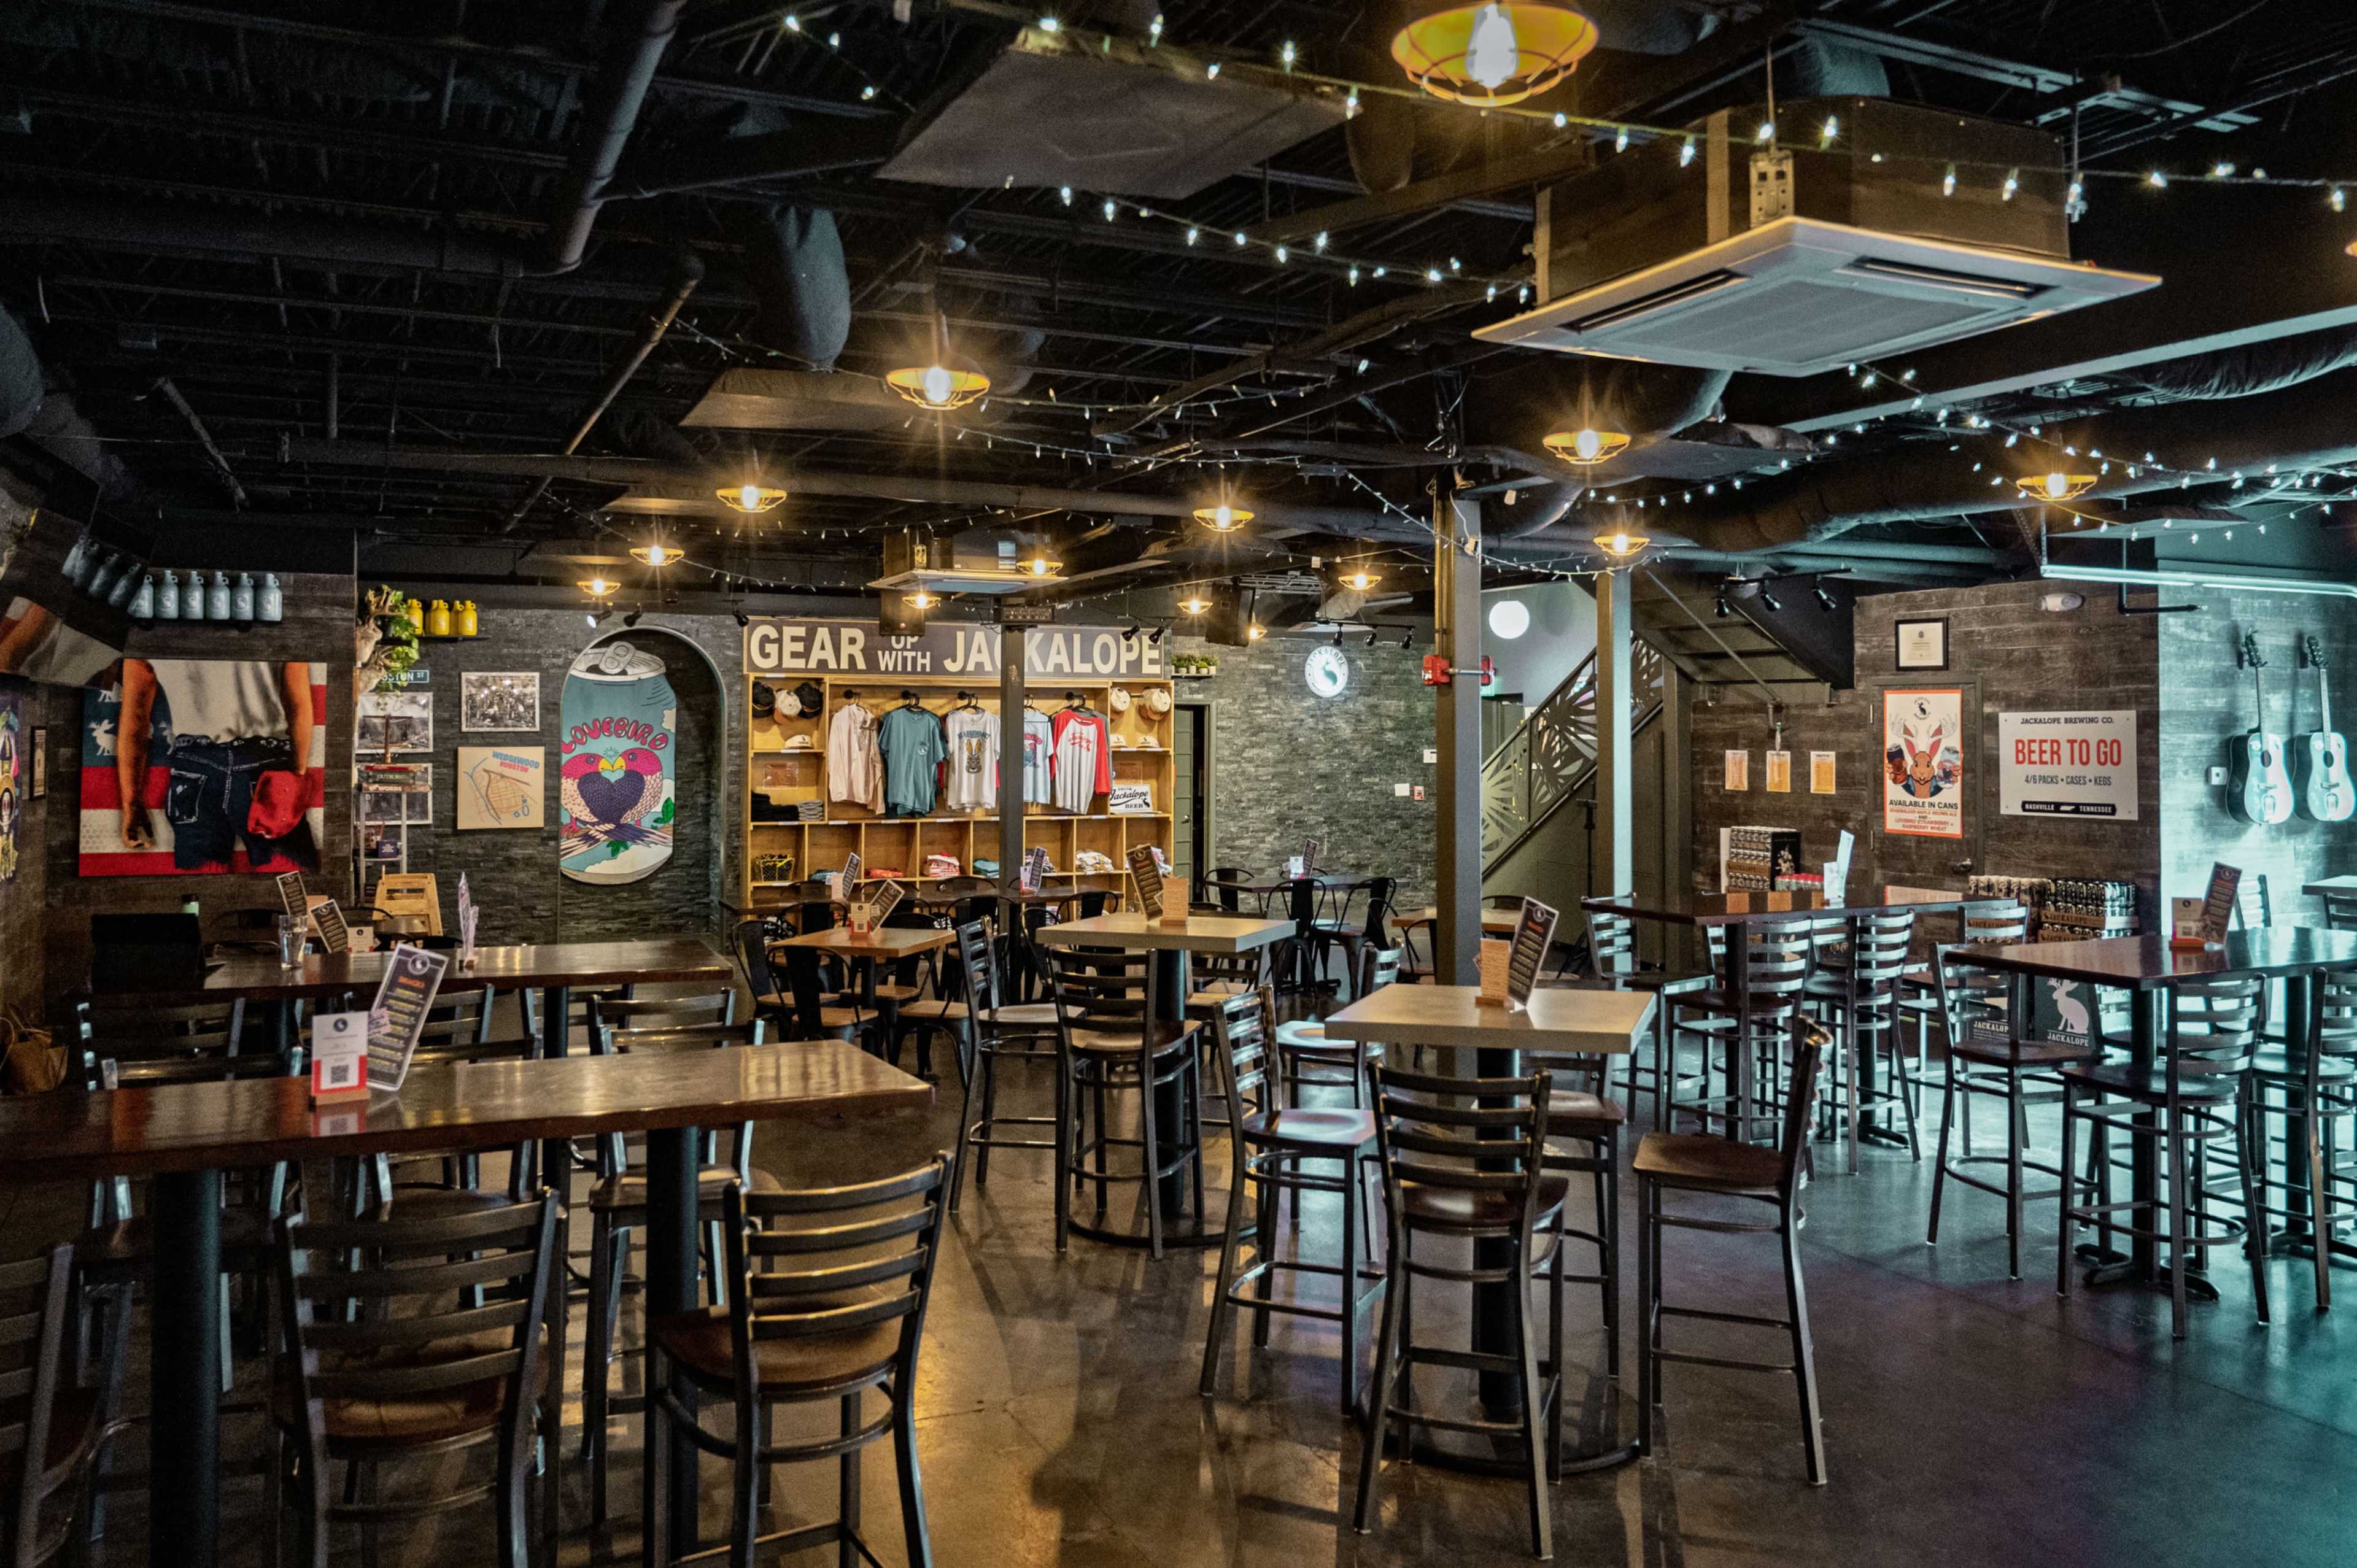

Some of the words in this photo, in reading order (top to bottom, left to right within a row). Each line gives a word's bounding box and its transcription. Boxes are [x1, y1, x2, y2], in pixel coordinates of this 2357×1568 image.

[750, 625, 867, 669] GEAR
[891, 635, 919, 649] UP
[943, 631, 1161, 674] JAKALOPE
[878, 651, 931, 672] WITH
[561, 717, 668, 754] LOVEBIRD
[492, 751, 540, 768] WEDGEWOOD
[2014, 739, 2062, 765] BEER
[2066, 739, 2091, 766] TO
[2096, 738, 2122, 766] GO
[2025, 775, 2037, 784] 4/6
[2038, 775, 2059, 785] PACKS
[2066, 776, 2087, 786] CASES
[2094, 776, 2111, 786] KEGS
[1110, 789, 1148, 801] Jackalope
[1889, 799, 1925, 808] AVAILABLE
[1973, 1021, 2009, 1032] JACKALOP
[2047, 1032, 2089, 1046] JACKALOPE
